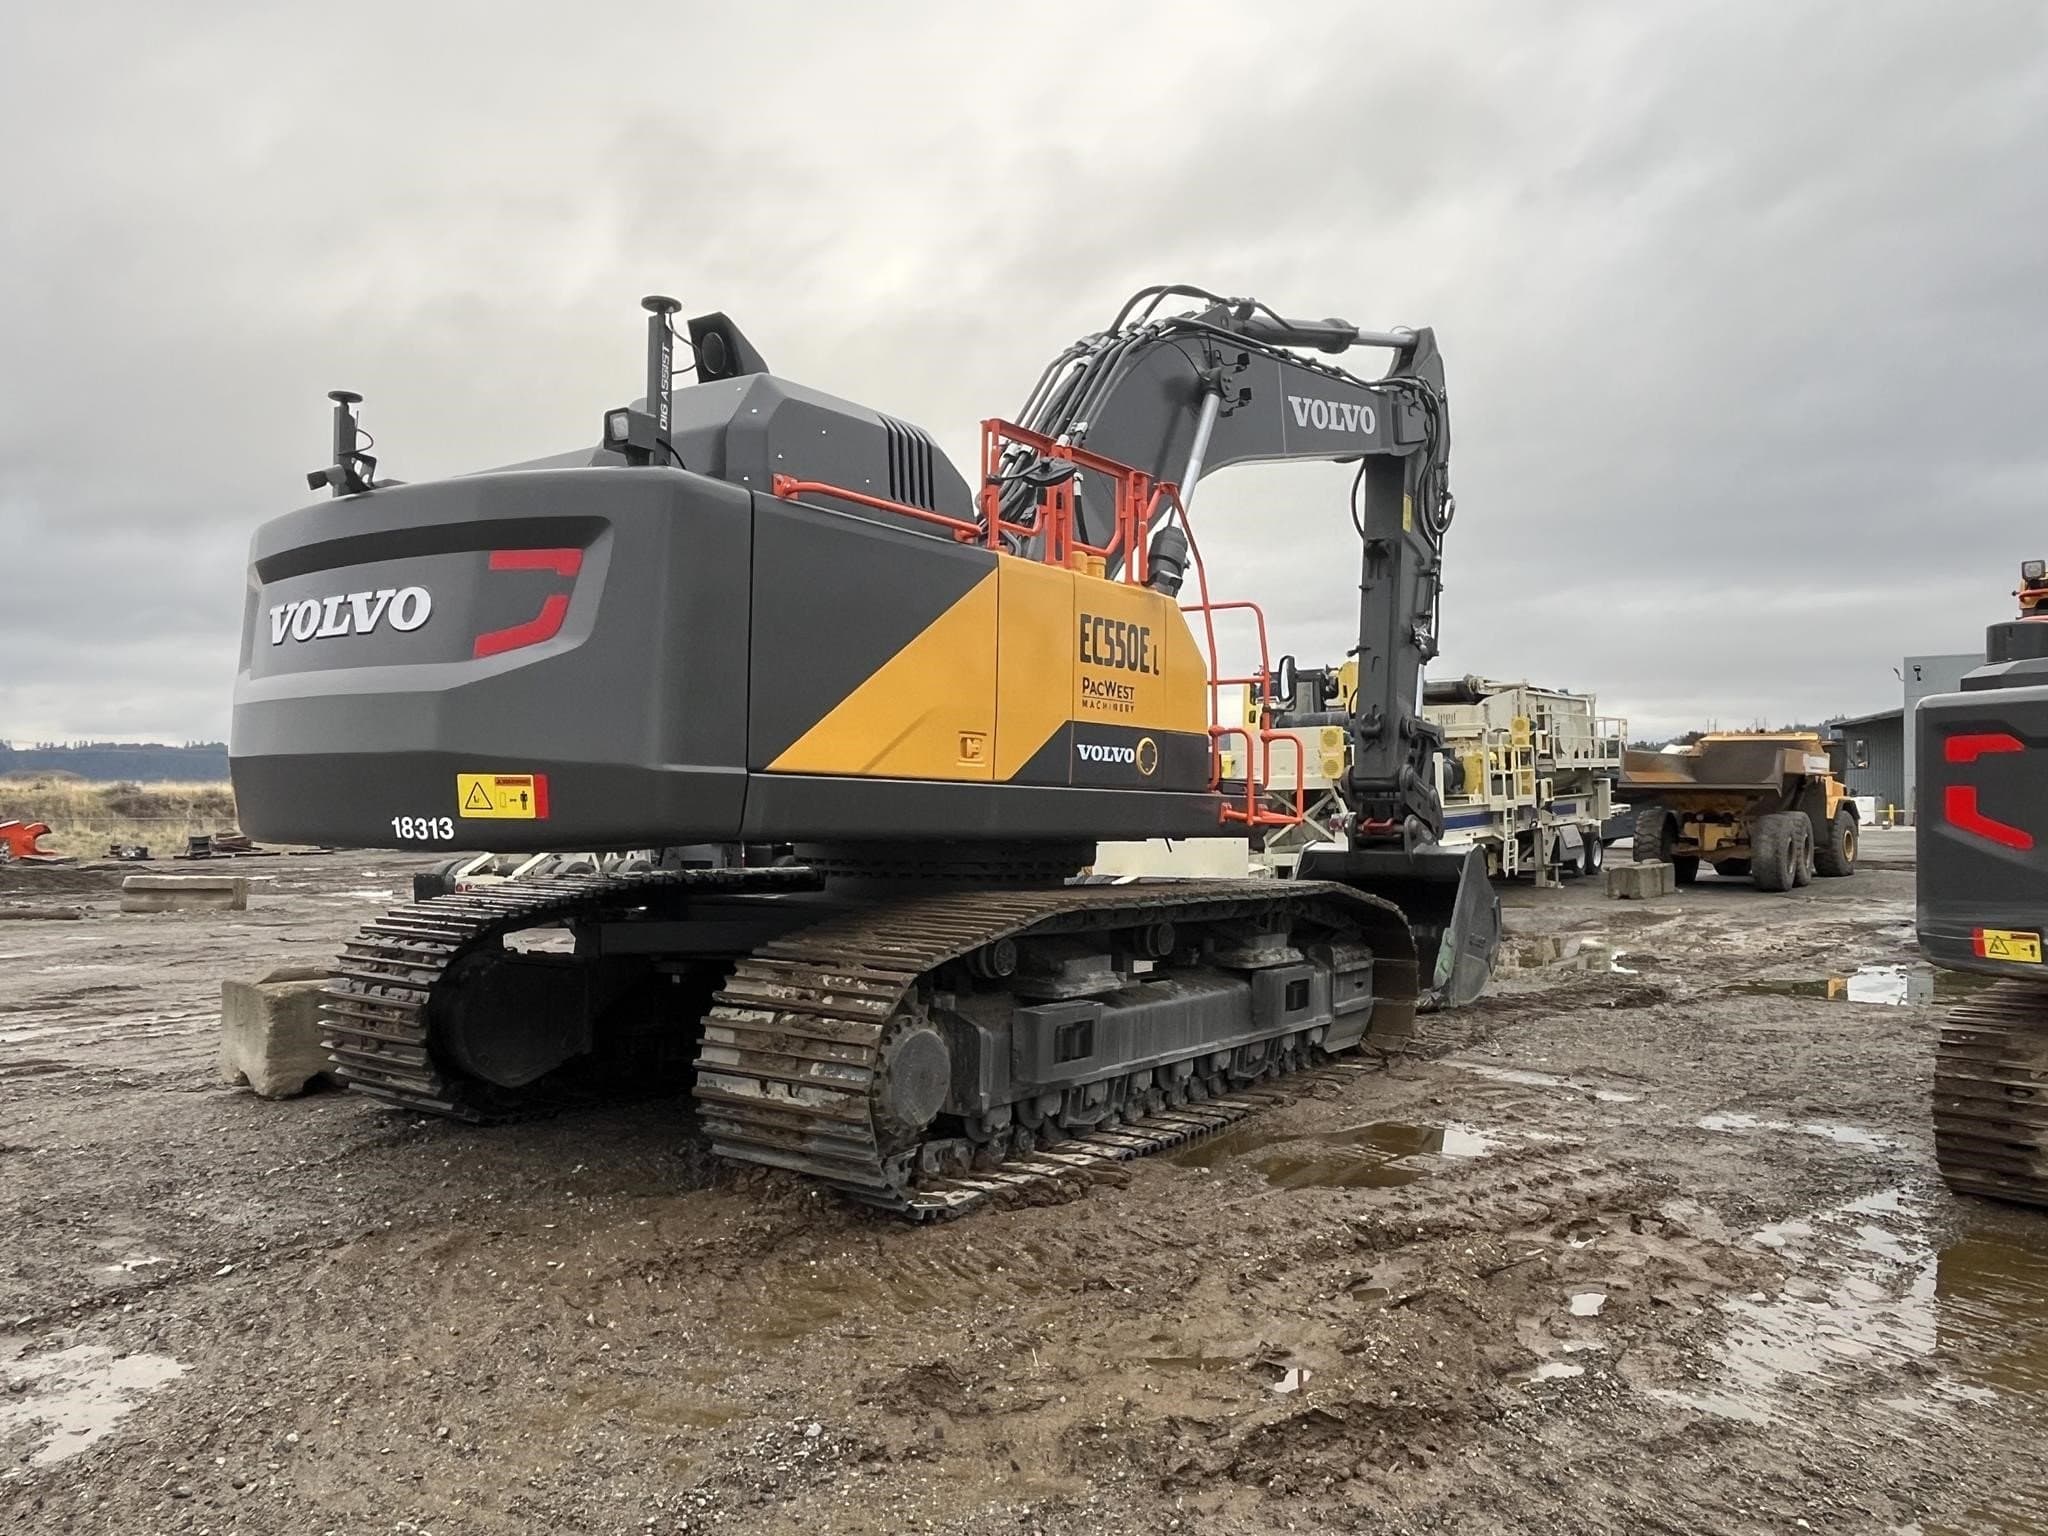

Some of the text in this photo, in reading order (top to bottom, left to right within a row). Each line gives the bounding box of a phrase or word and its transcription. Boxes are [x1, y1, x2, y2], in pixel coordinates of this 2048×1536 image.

[660, 342, 671, 431] DIG ASSIST
[1288, 396, 1375, 434] VOLVO
[269, 586, 432, 645] VOLVO
[1080, 613, 1150, 673] EC550E
[1082, 699, 1134, 713] MACHINERY
[1077, 743, 1135, 763] VOLVO
[391, 816, 454, 840] 18313
